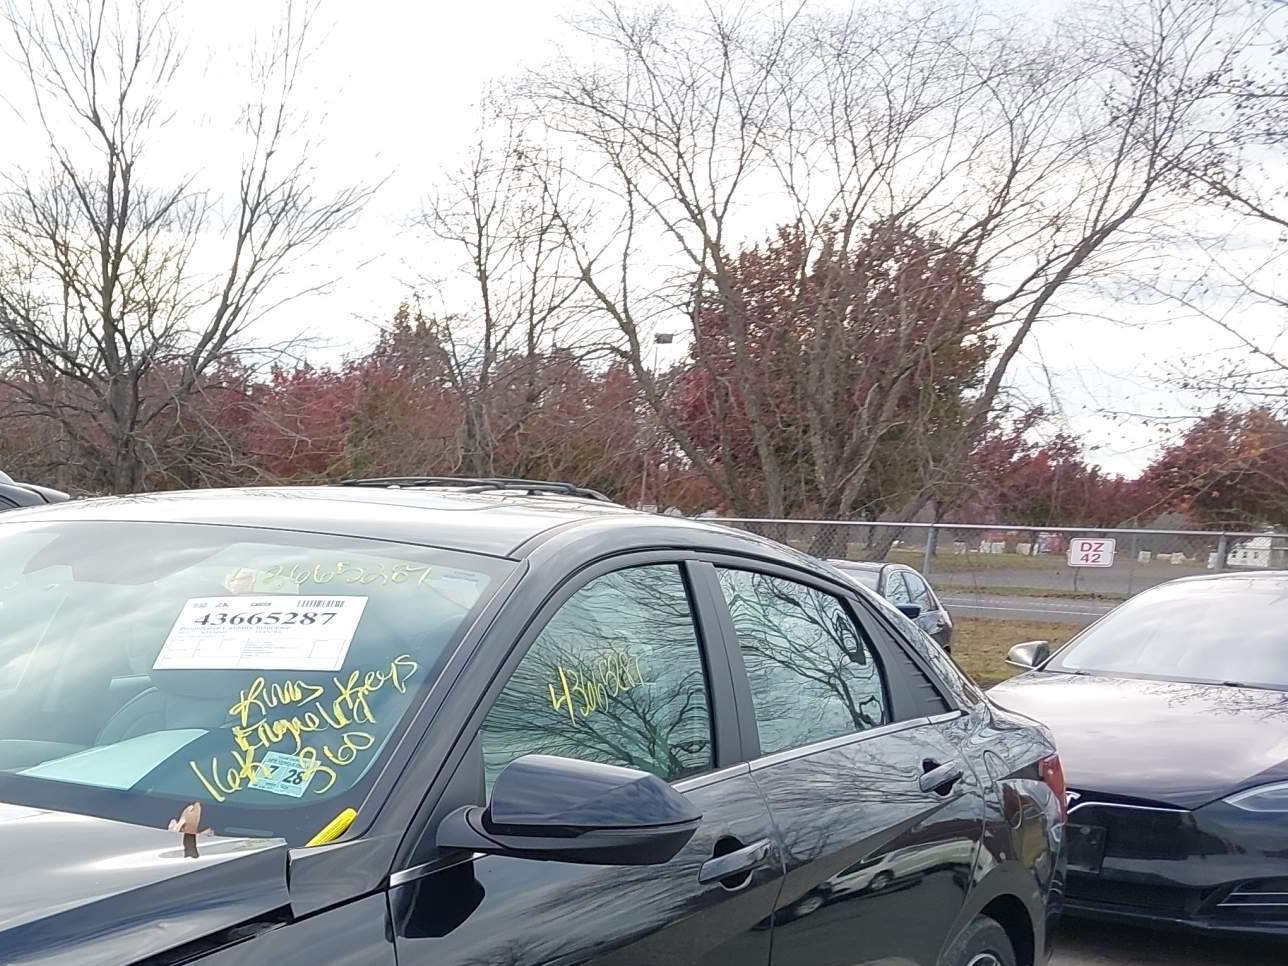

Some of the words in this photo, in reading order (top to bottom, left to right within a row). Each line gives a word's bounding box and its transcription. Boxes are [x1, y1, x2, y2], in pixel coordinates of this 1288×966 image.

[1080, 542, 1105, 552] DZ
[1079, 553, 1102, 563] 42
[193, 611, 338, 626] 43665287
[282, 768, 306, 785] 28
